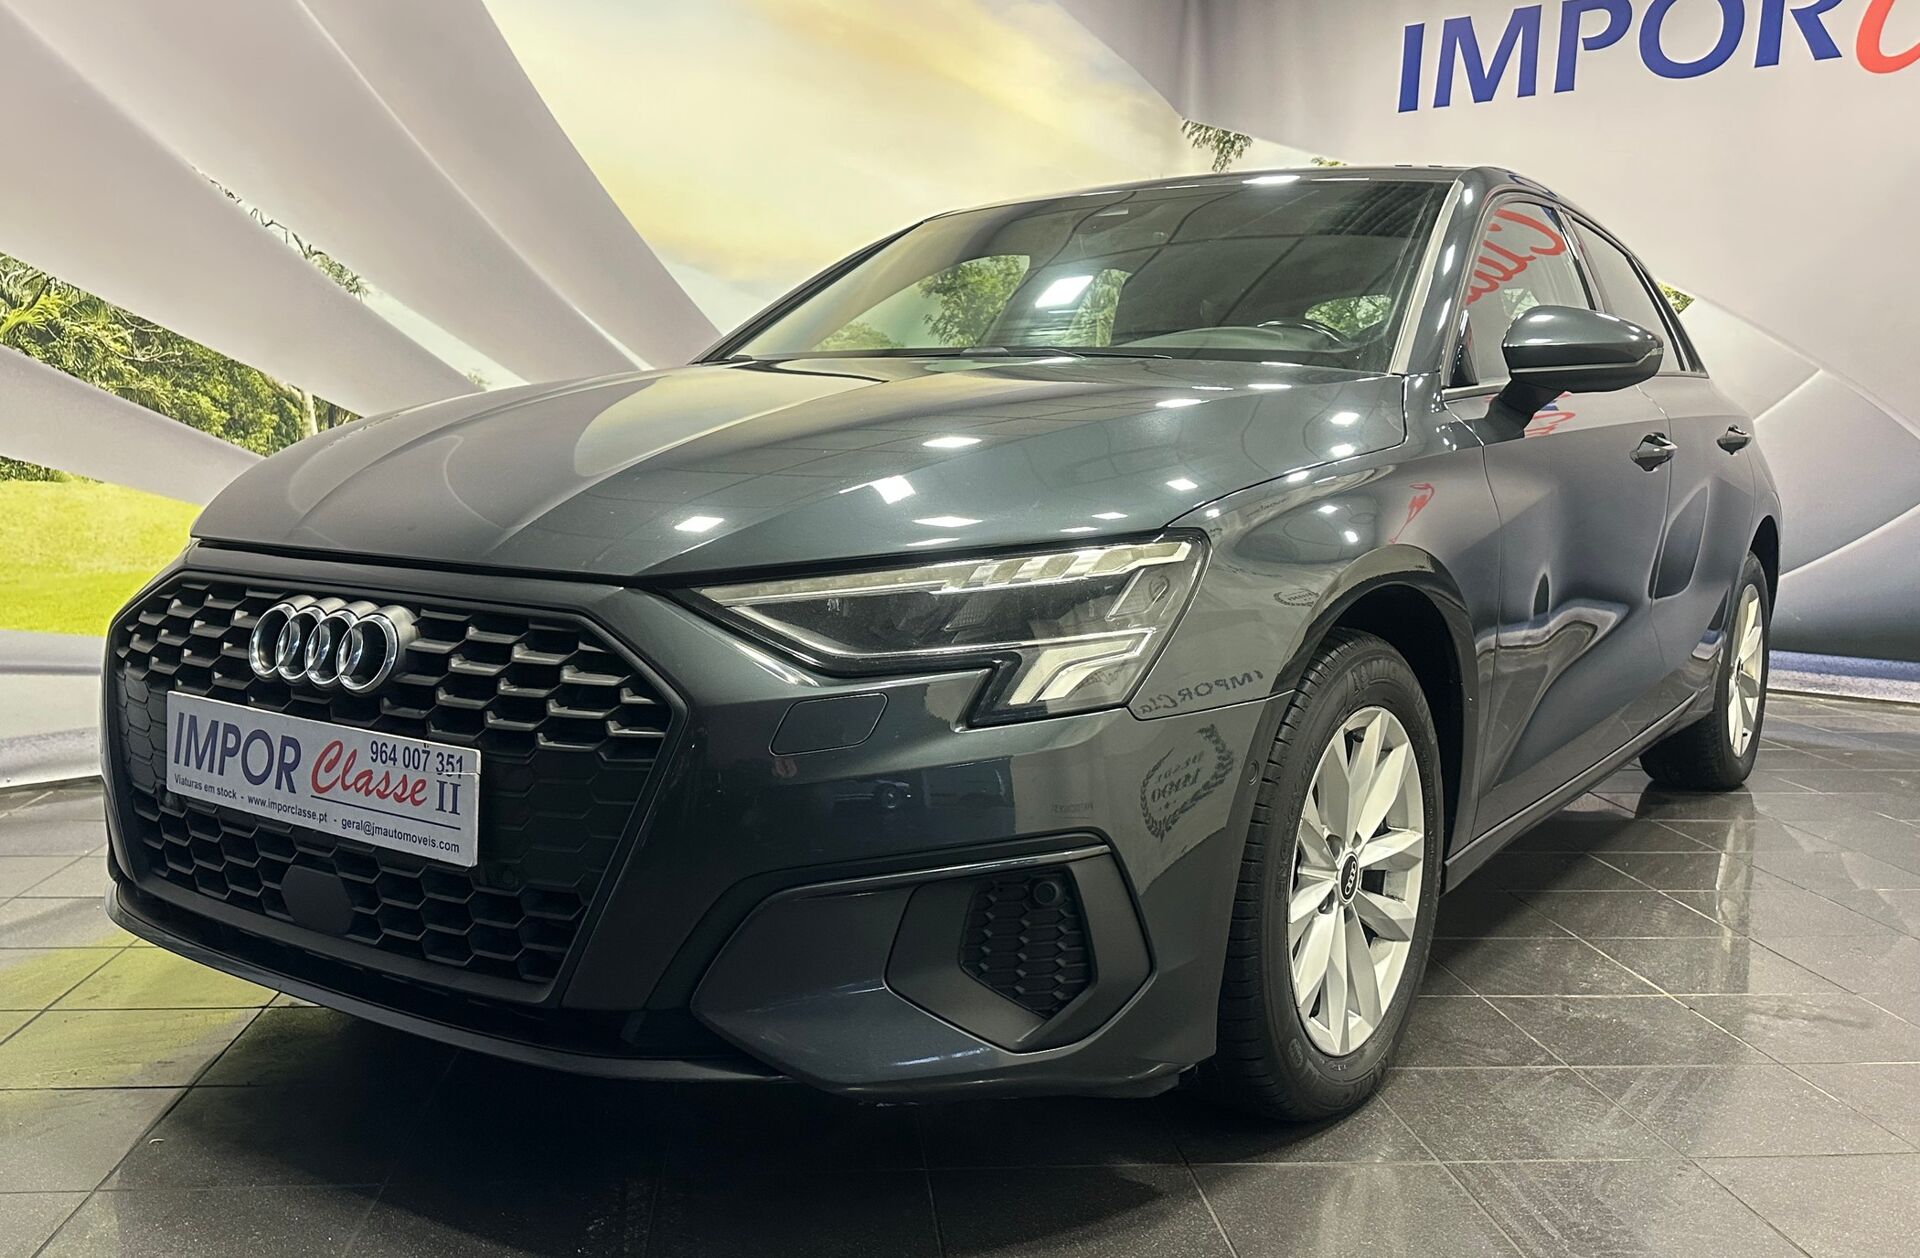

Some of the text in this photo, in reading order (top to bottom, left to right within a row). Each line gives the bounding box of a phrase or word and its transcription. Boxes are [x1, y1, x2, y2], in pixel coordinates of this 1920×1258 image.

[1398, 0, 1842, 113] IMPOR
[173, 712, 461, 815] IMPOR Classe II
[370, 740, 464, 779] 964 007 351
[174, 773, 203, 791] Viaturas
[204, 784, 215, 794] em
[216, 786, 237, 800] stock
[248, 795, 328, 823] www.imporclasse.pt
[341, 817, 460, 853] geral@jmautomoveis.com
